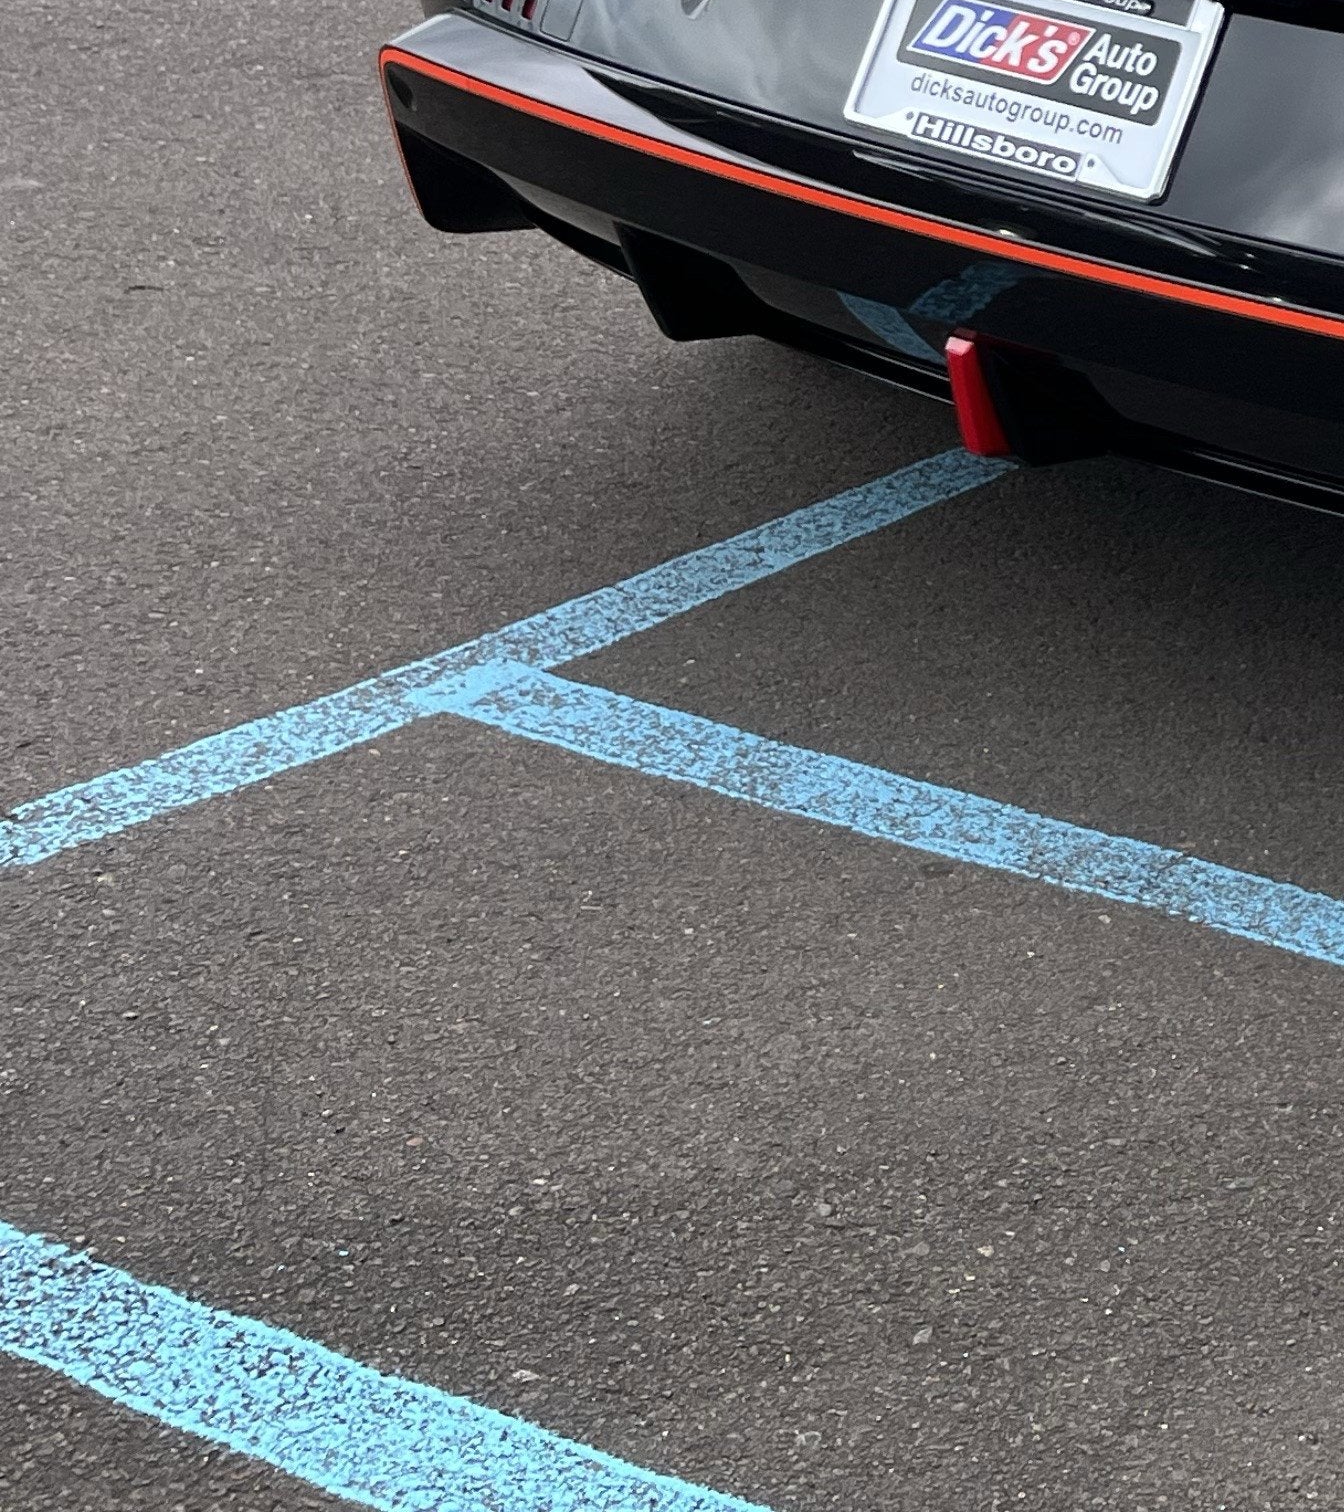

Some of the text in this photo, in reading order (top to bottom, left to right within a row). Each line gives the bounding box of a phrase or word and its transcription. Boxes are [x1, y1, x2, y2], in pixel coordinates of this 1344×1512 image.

[921, 4, 1158, 76] Dick's Auto
[910, 72, 1124, 145] dicksautogroup.com
[1069, 62, 1160, 116] Group
[914, 114, 1078, 174] Hillsboro
